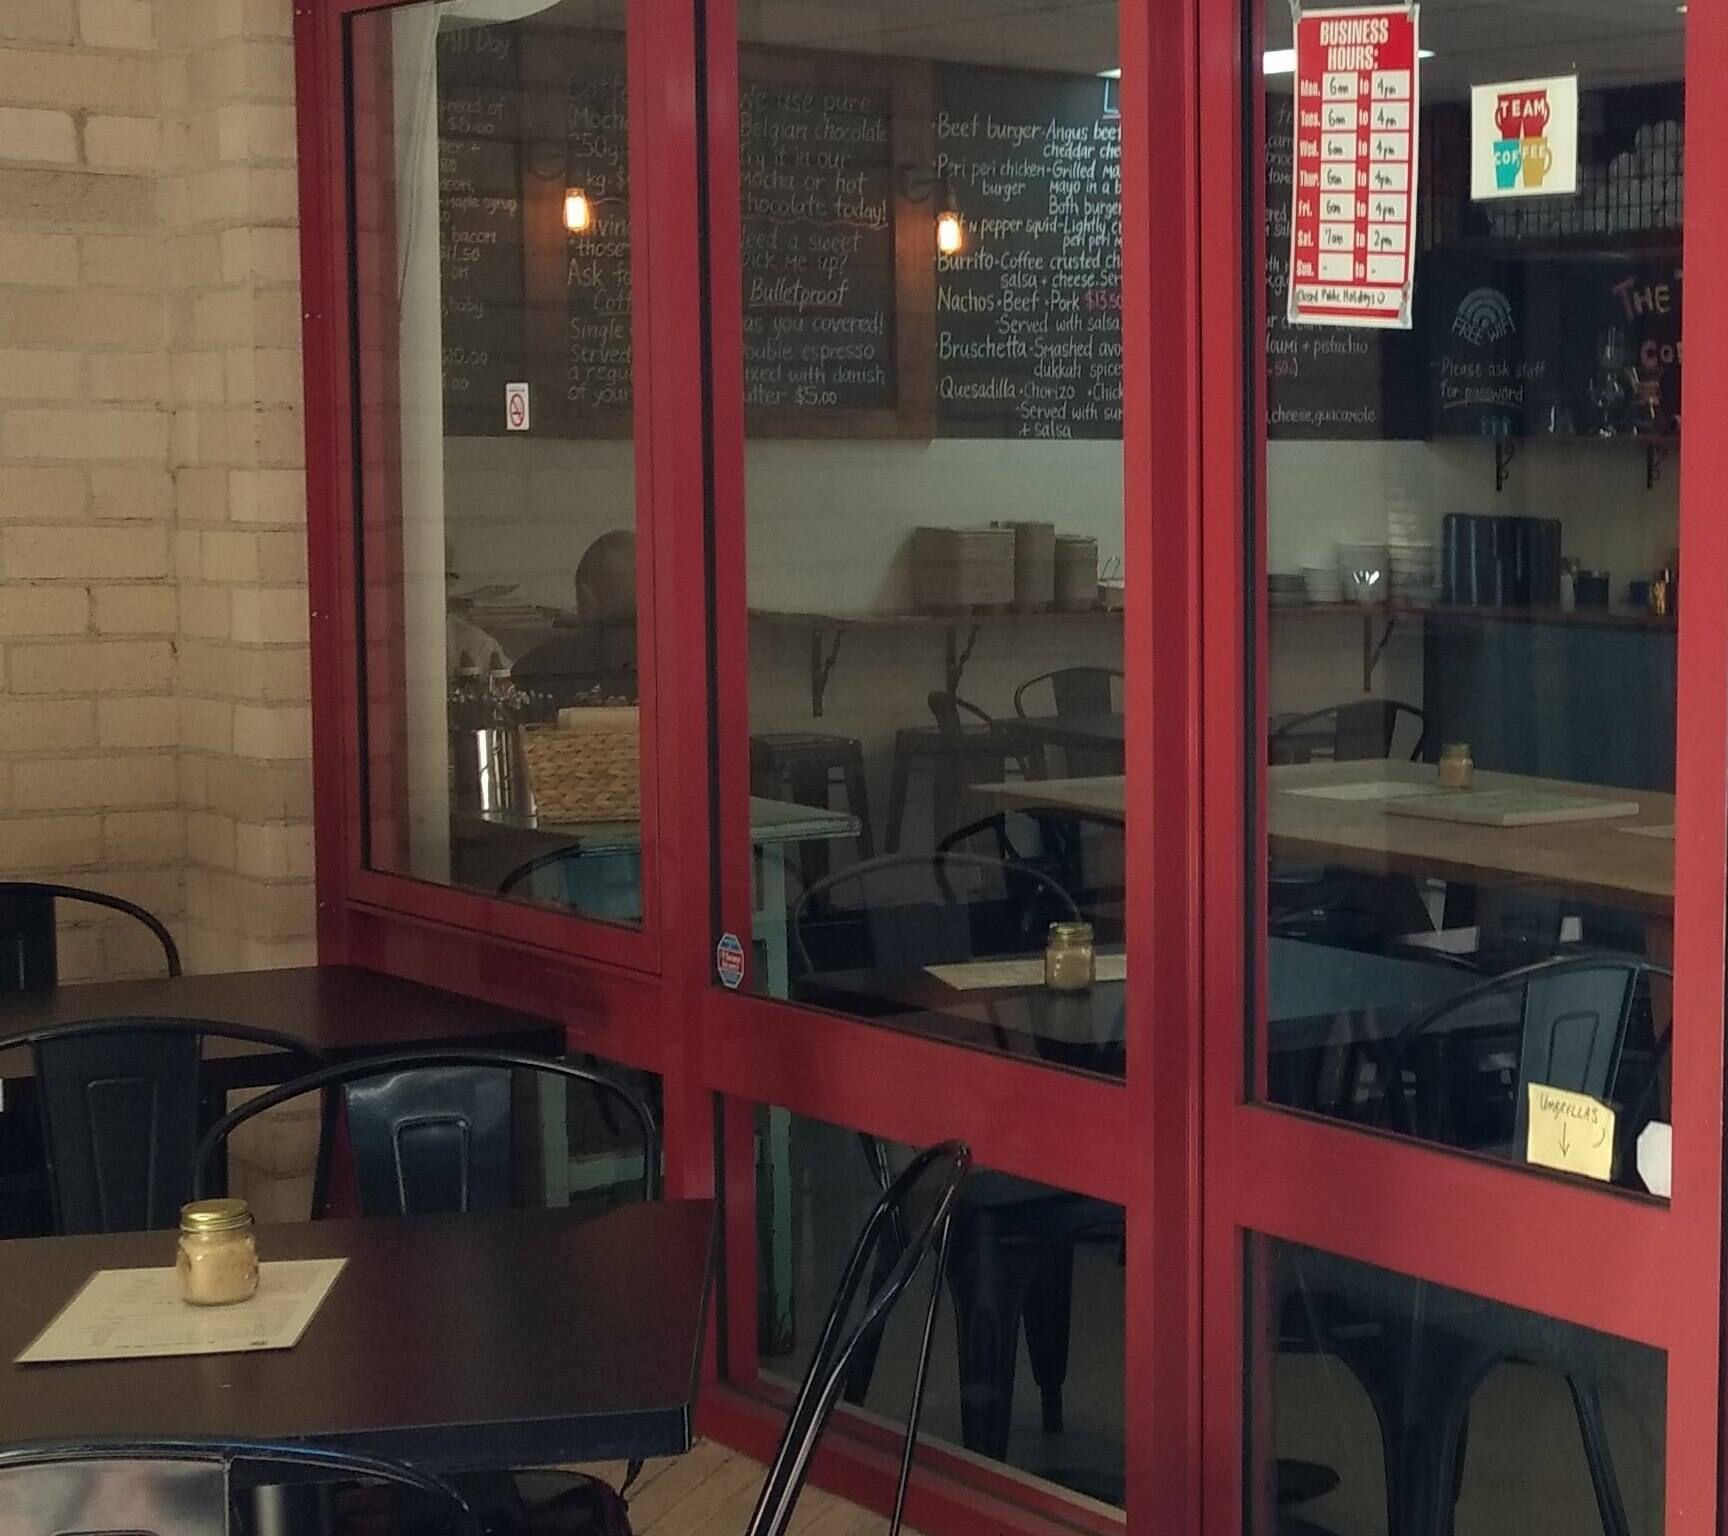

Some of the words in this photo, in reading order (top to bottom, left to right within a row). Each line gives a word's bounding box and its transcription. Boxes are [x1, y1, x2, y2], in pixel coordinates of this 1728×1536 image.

[1320, 17, 1389, 46] BUSINESS
[1328, 45, 1378, 71] HOURS:
[1300, 79, 1320, 96] Mon.
[1360, 78, 1369, 95] to
[1300, 110, 1320, 128] Tues.
[1359, 108, 1369, 126] to
[1500, 97, 1546, 119] TEAM
[938, 112, 980, 138] Beef
[1043, 141, 1096, 159] cheddar
[1299, 139, 1319, 158] Wed.
[1359, 139, 1368, 157] to
[836, 170, 869, 196] hot
[1357, 169, 1367, 187] to
[982, 178, 1027, 202] burger
[1049, 194, 1080, 216] Both
[1299, 199, 1313, 217] Fri.
[1356, 200, 1366, 218] to
[1298, 229, 1314, 247] Sat.
[1356, 229, 1366, 248] to
[1050, 245, 1102, 271] crusted
[1297, 258, 1315, 277] Sun.
[1355, 260, 1365, 279] to
[568, 258, 605, 287] Ask
[1000, 269, 1038, 290] salsa
[750, 276, 849, 312] Bulletproof
[937, 284, 995, 313] Nachos
[1002, 288, 1041, 313] Beef
[1051, 288, 1081, 313] Pork
[1611, 276, 1672, 322] THE
[570, 317, 625, 345] Single
[774, 317, 804, 340] you
[998, 311, 1049, 335] Served
[1055, 311, 1083, 333] with
[802, 343, 876, 367] espresso
[939, 330, 1028, 361] Bruschetta
[789, 364, 826, 385] with
[1033, 357, 1082, 380] dukkah
[1440, 357, 1482, 378] Please
[939, 375, 1017, 401] Quesadilla
[1019, 399, 1069, 421] Served
[1071, 401, 1099, 422] with
[1034, 419, 1074, 440] salsa
